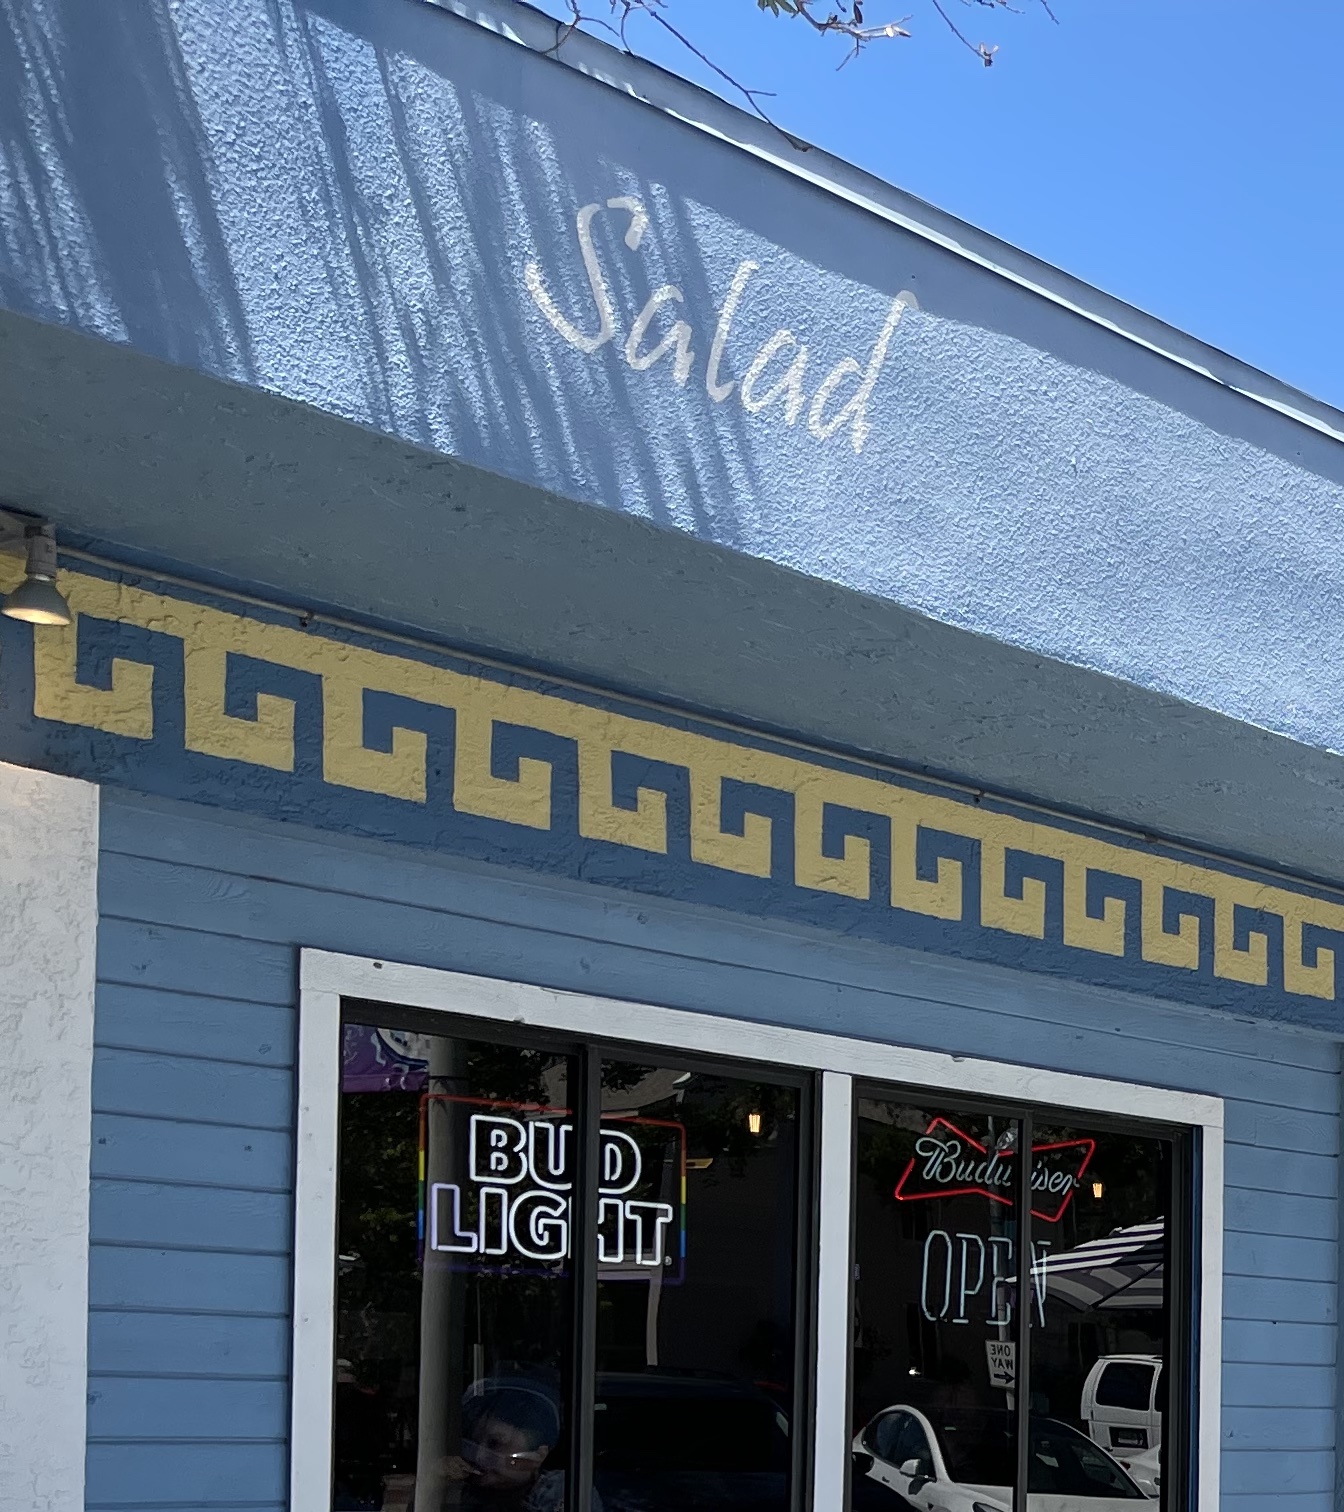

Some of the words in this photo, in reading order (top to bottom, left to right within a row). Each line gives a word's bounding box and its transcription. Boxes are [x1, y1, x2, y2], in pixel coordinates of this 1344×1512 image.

[525, 195, 918, 454] Salad
[469, 1114, 642, 1194] BUD
[921, 1229, 1051, 1328] OPEN
